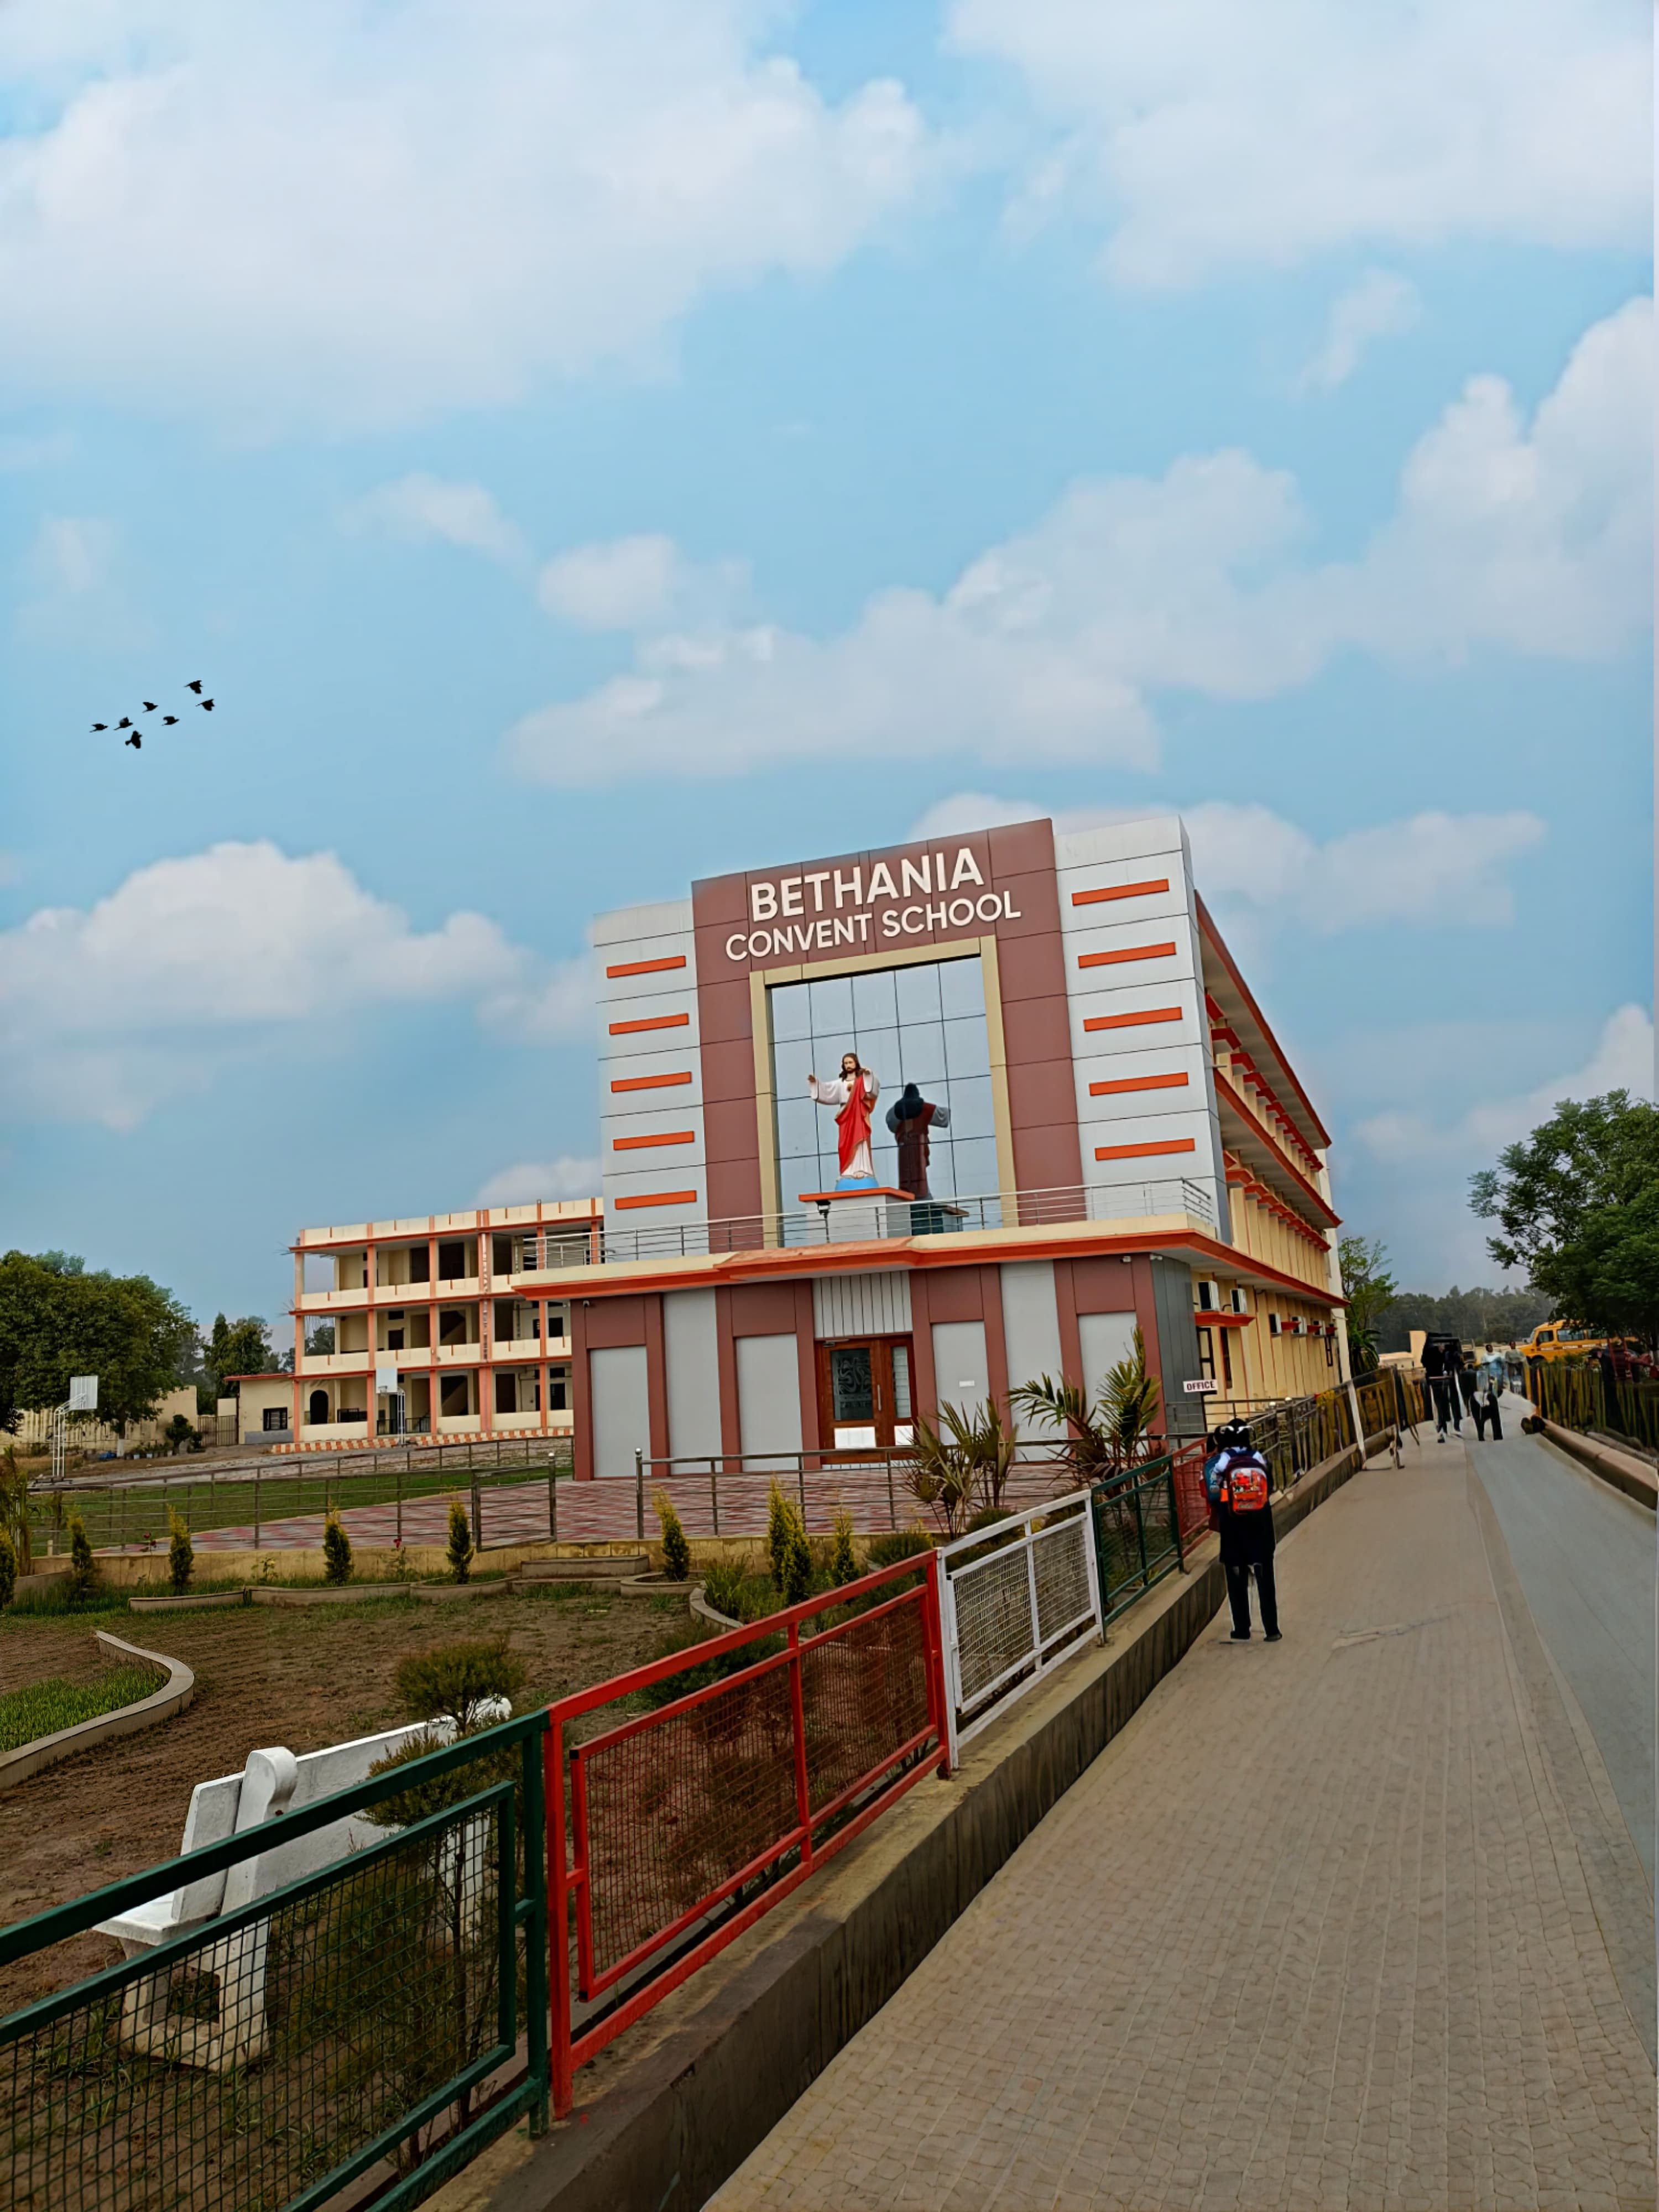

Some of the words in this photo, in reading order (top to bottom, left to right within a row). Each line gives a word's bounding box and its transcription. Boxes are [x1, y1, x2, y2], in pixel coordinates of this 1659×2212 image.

[750, 847, 984, 922] BETHANIA
[726, 913, 873, 962] CONVENT
[881, 890, 1022, 938] SCHOOL
[1186, 1380, 1215, 1390] OFFICE
